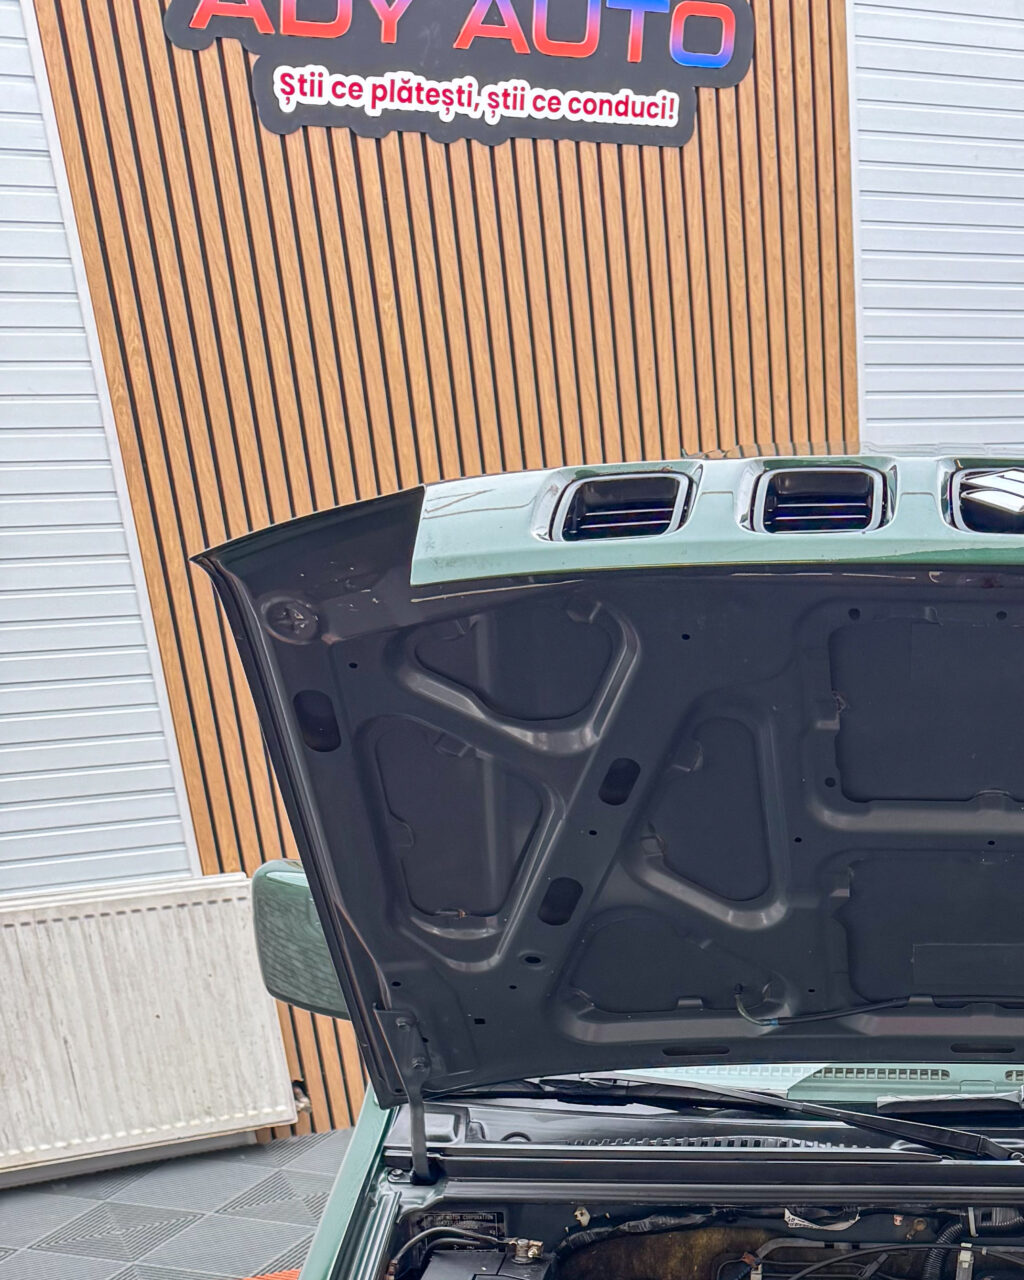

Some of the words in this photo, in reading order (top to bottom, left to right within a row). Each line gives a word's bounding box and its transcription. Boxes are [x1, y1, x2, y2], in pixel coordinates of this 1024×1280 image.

[453, 0, 736, 68] AUTO
[280, 72, 324, 105] Știi
[331, 80, 364, 100] ce
[371, 78, 480, 115] plătești,
[487, 86, 525, 118] știi
[532, 94, 562, 113] ce
[567, 95, 675, 120] conduci!
